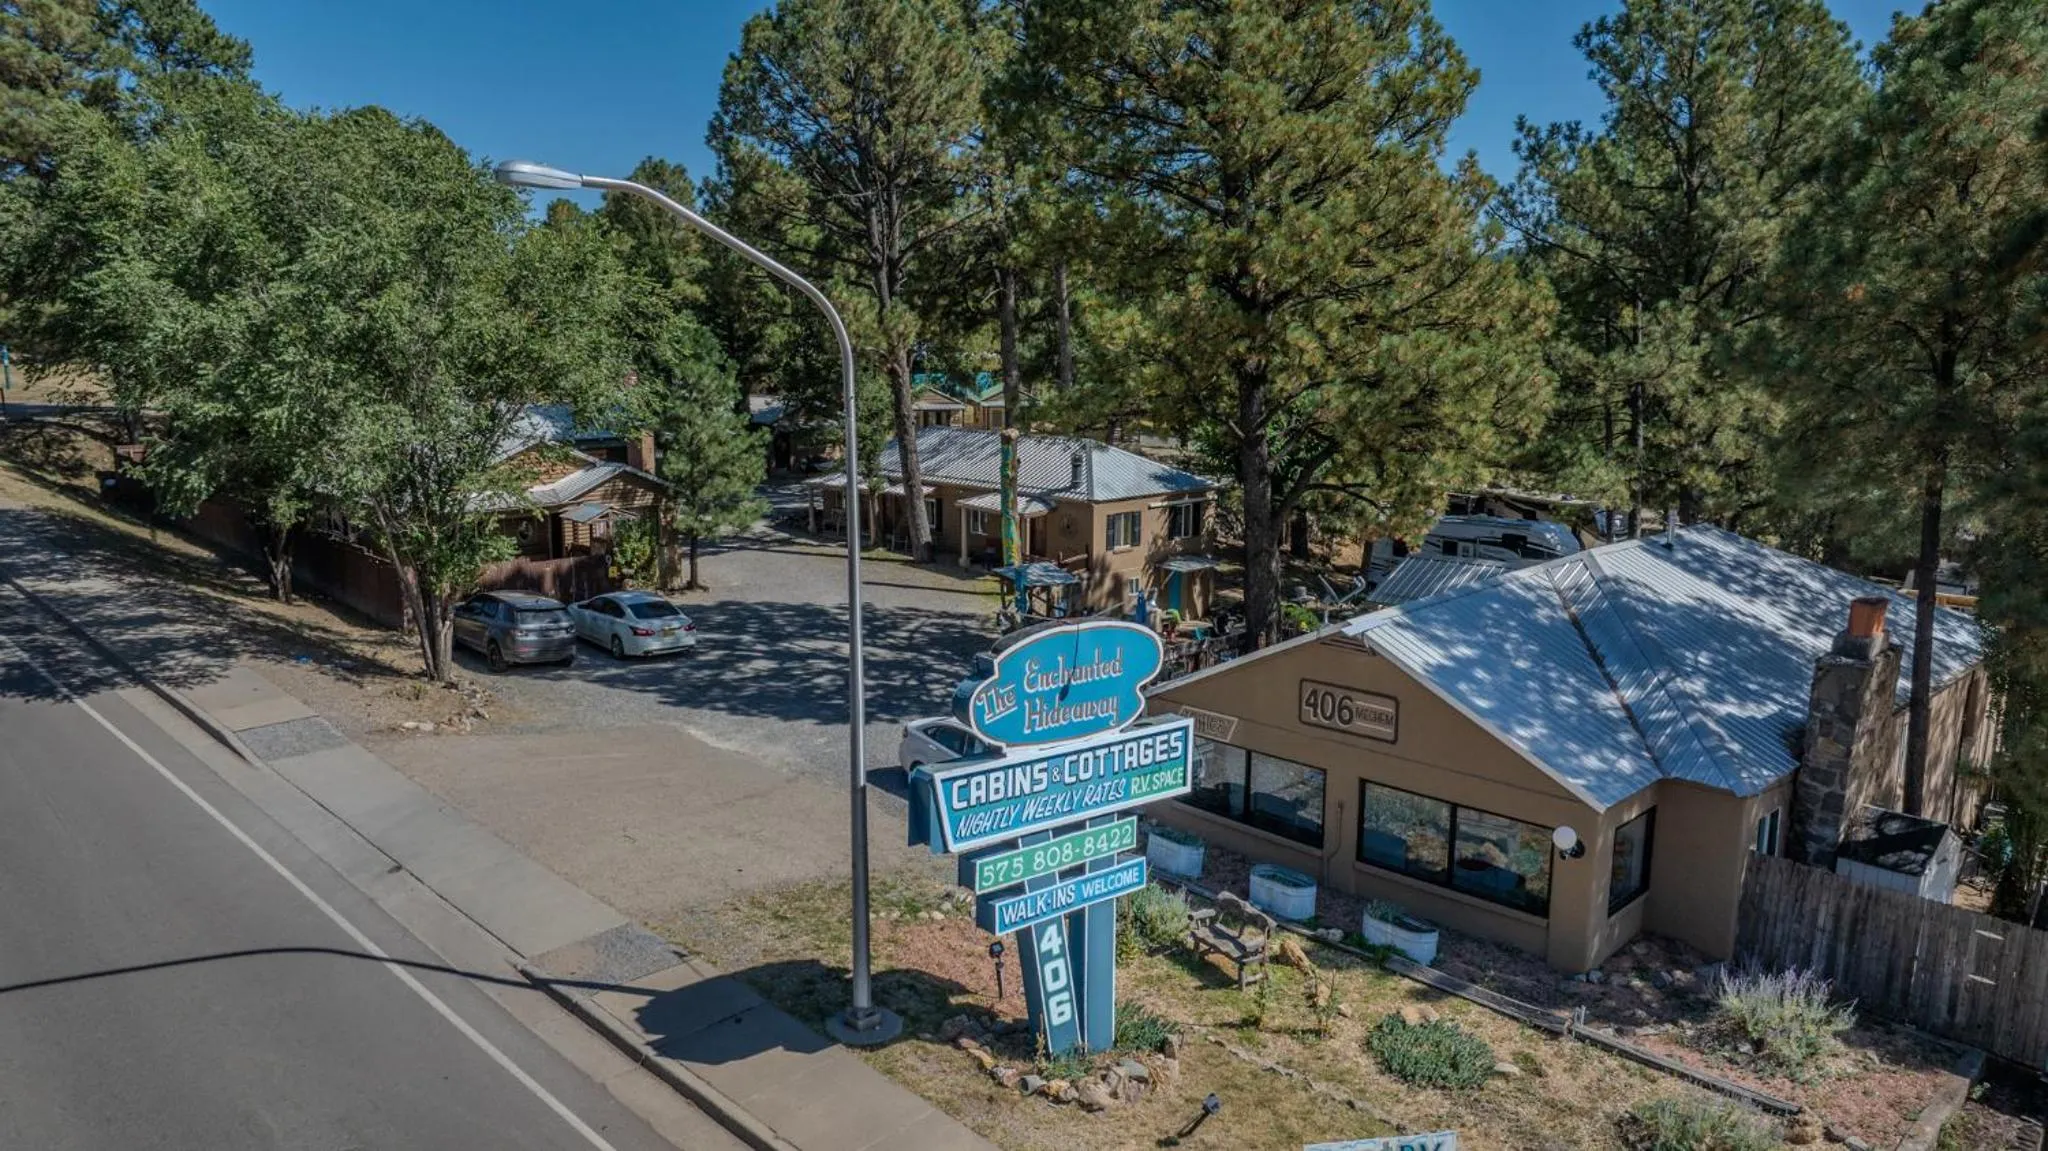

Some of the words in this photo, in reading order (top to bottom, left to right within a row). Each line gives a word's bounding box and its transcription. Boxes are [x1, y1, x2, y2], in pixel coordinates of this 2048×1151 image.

[1024, 647, 1123, 693] Enchanted
[975, 682, 1017, 722] The
[1024, 694, 1119, 734] Hideaway
[1304, 688, 1353, 727] 406
[952, 761, 1048, 810] CABINS
[1052, 767, 1060, 782] &
[1063, 731, 1184, 784] COTTAGES
[1152, 767, 1184, 791] SPACE
[955, 804, 1021, 838] NIGHTLY
[1021, 791, 1081, 822] WEEKLY
[1082, 778, 1127, 808] RATES
[982, 857, 1024, 886] 575
[1034, 825, 1133, 871] 808-8422
[1081, 867, 1140, 898] WELCOME
[1040, 923, 1073, 1027] 406
